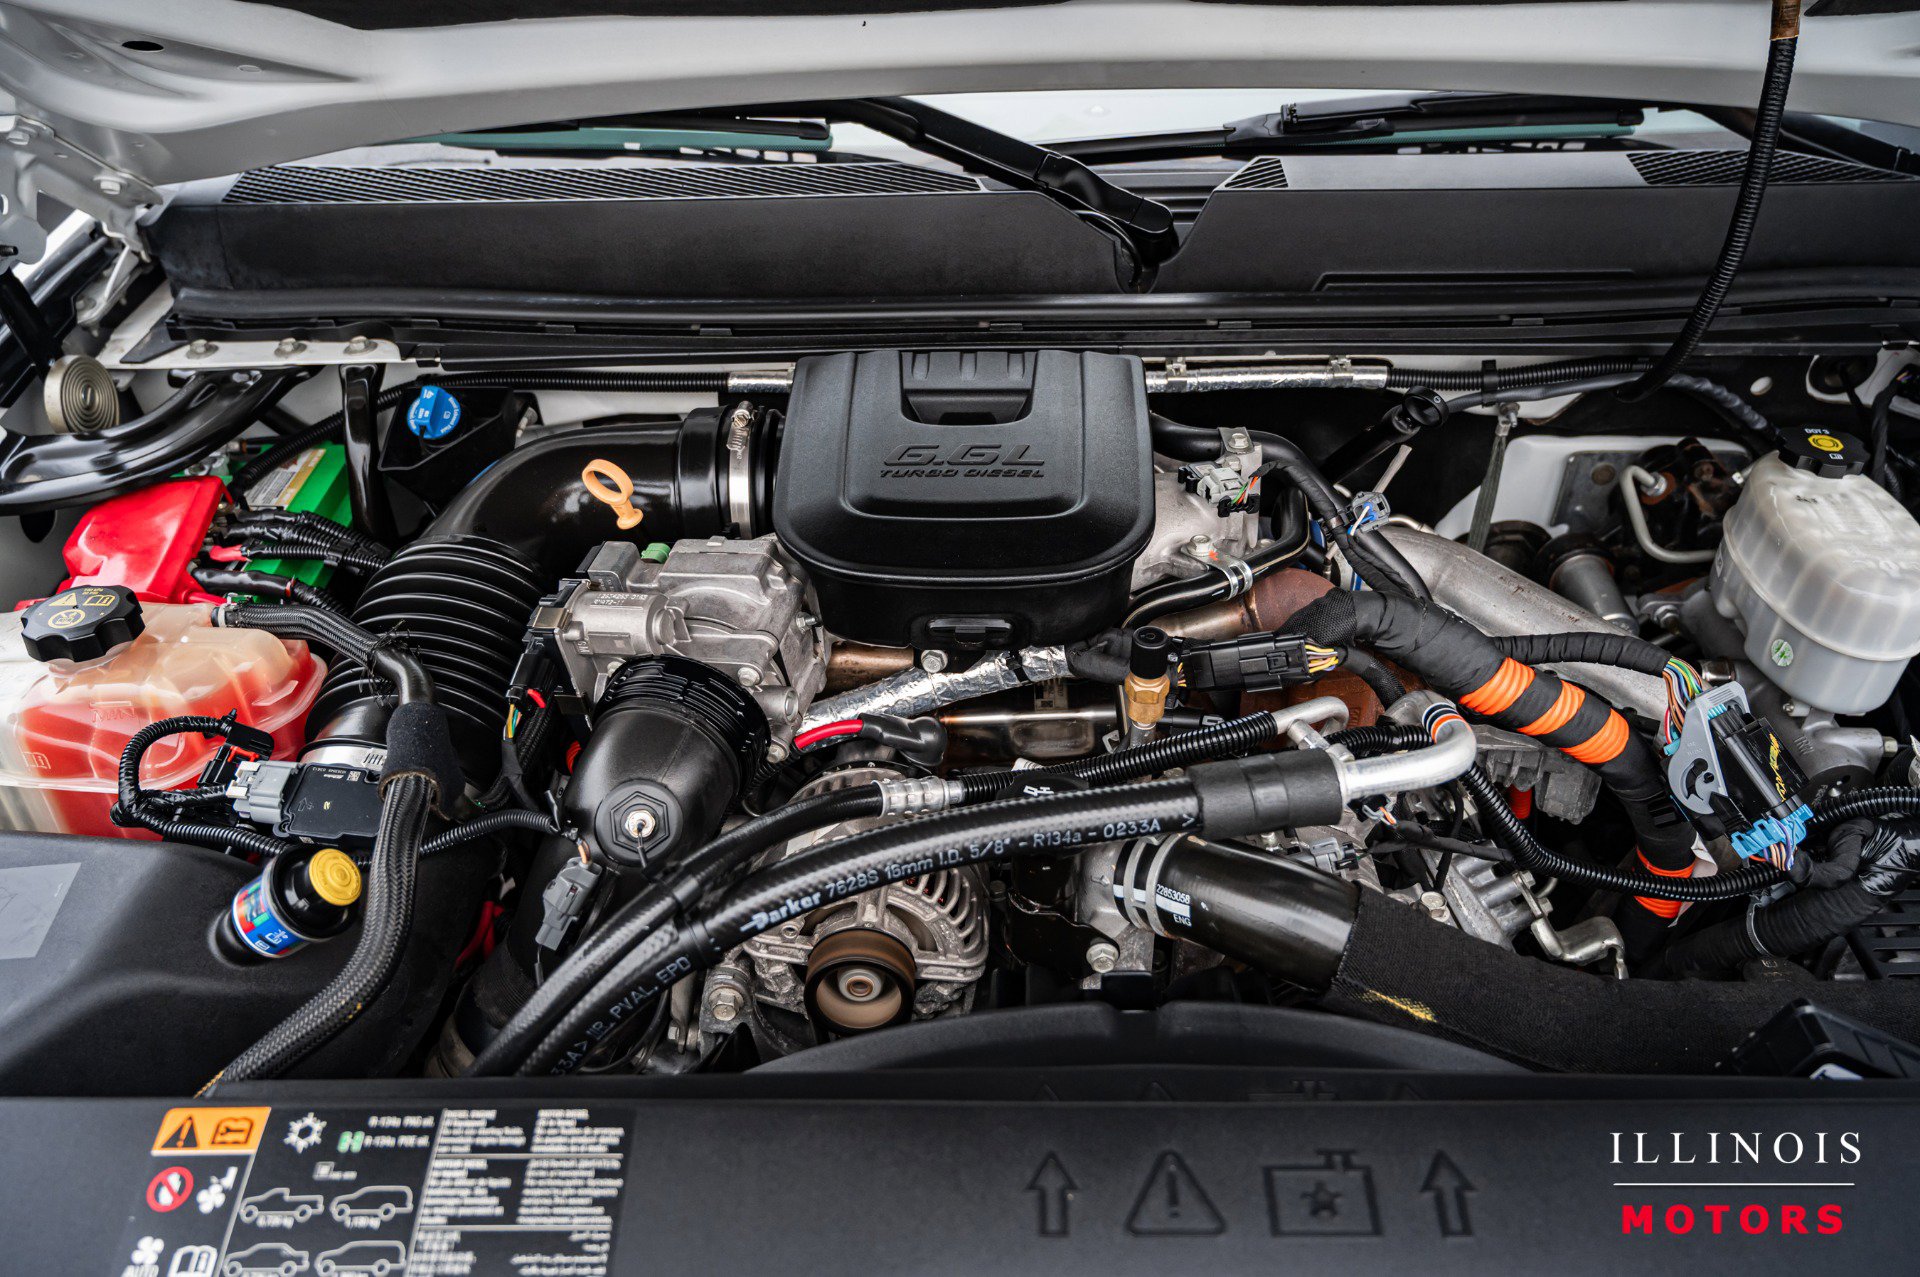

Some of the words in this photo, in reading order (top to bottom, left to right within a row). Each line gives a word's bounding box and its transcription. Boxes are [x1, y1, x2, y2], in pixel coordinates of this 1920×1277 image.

[884, 444, 1045, 466] 6.6L
[880, 469, 959, 478] TURBO
[963, 469, 1045, 478] DIESEL
[740, 891, 821, 932] Parker
[825, 869, 879, 898] 7628S
[884, 857, 934, 879] 16mm
[1033, 831, 1083, 848] R134a
[1103, 818, 1161, 839] 0233A
[1156, 884, 1191, 904] 22853058
[1173, 913, 1192, 927] ENG
